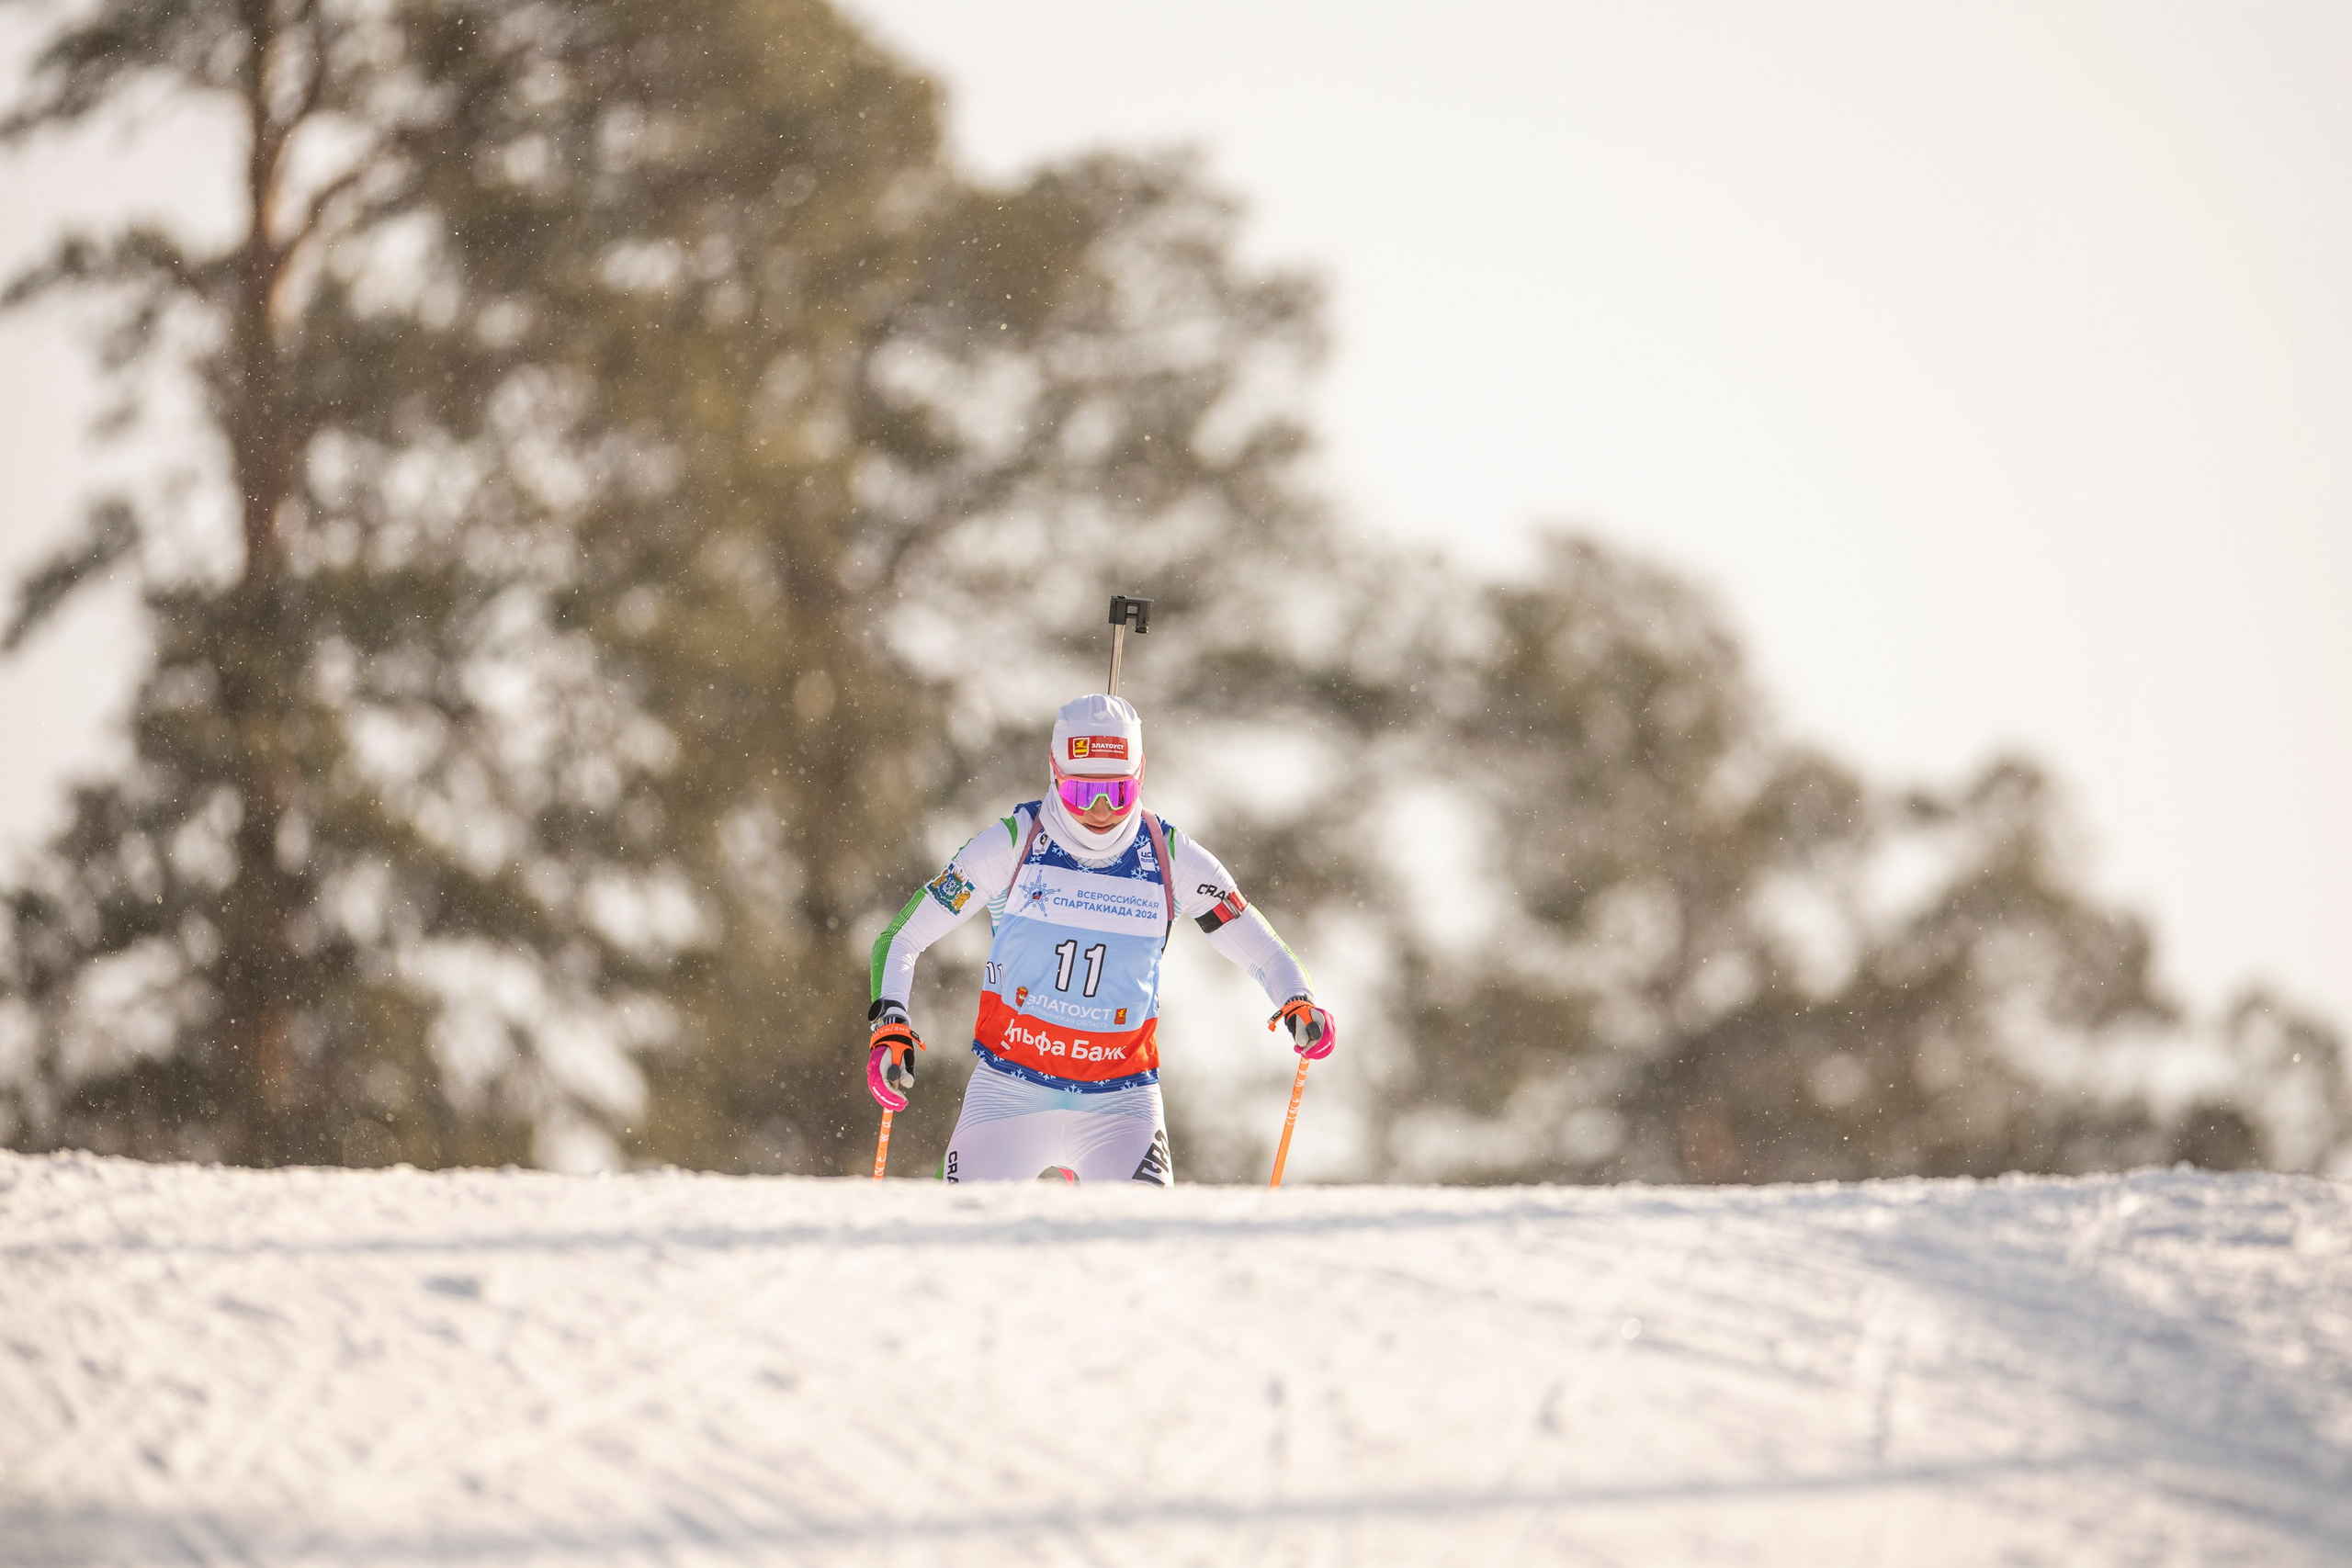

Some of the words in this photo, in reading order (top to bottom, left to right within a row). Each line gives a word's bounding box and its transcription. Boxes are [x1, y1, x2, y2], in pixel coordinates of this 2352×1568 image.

[1091, 742, 1124, 750] ЗЛАТОУСТ
[1077, 890, 1159, 909] ВСЕРОССИЙСКАЯ
[1196, 884, 1230, 901] CRA
[1053, 897, 1133, 917] СПАРТАКИАДА
[1135, 908, 1158, 919] 2024
[1055, 939, 1106, 998] 11
[1026, 994, 1112, 1021] ЗЛАТОУСТ
[1077, 1019, 1108, 1028] ОБЛАСТЬ
[947, 1150, 959, 1185] CRA
